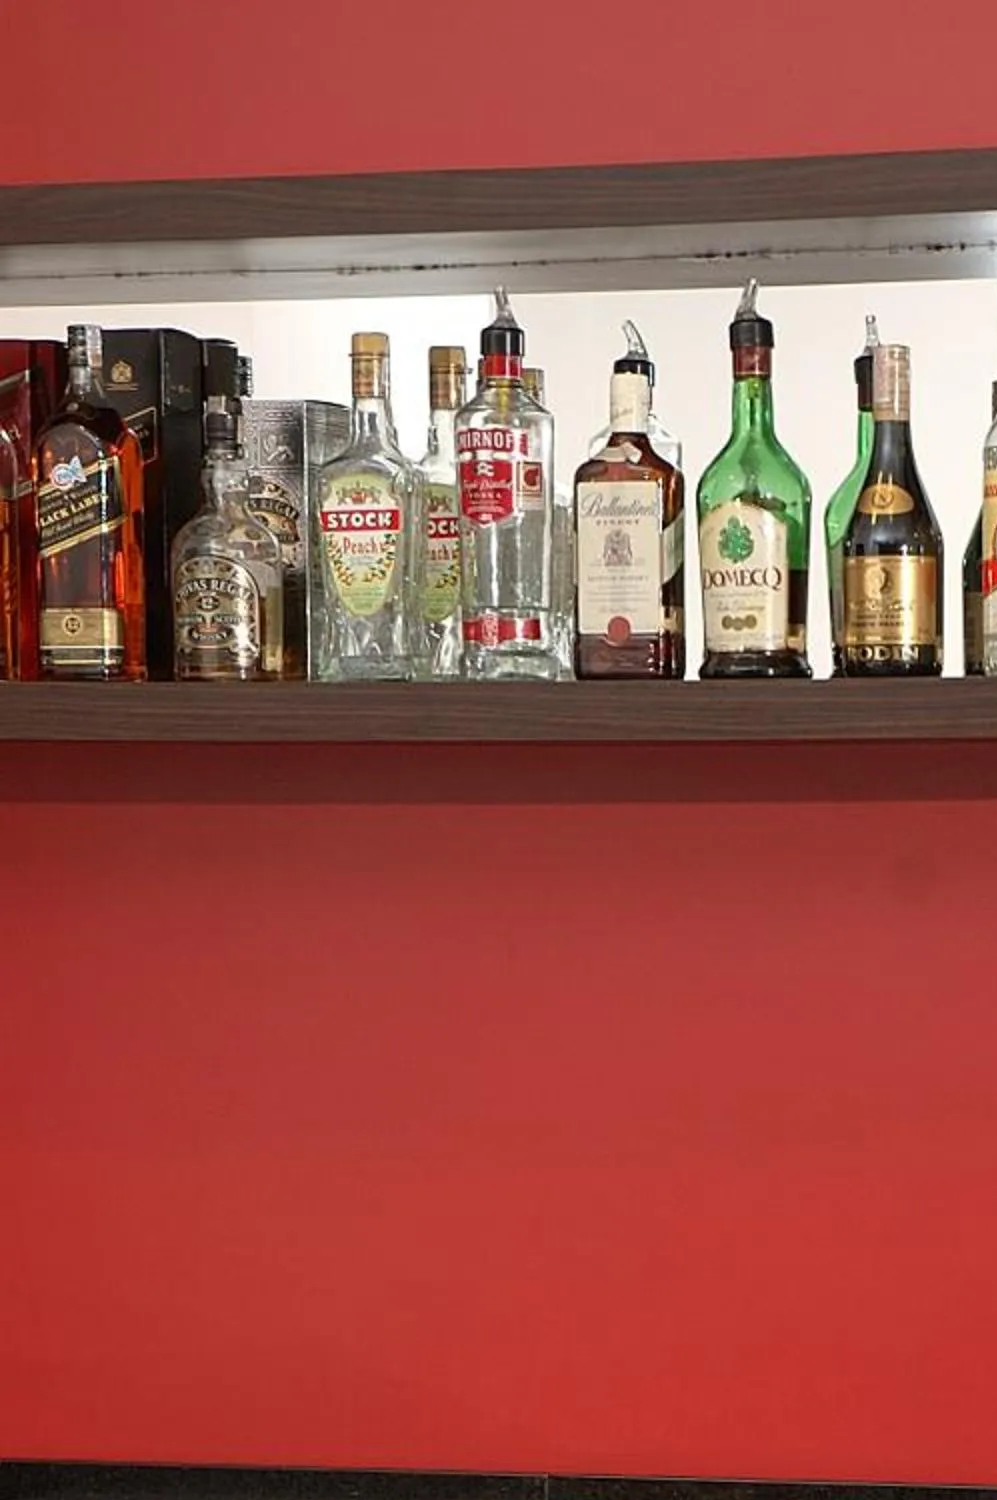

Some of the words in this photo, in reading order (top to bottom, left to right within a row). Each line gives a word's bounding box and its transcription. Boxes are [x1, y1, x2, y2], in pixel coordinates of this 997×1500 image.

[458, 431, 522, 451] MIRNOF
[39, 505, 73, 527] LACK
[70, 494, 104, 514] LABE
[327, 512, 392, 529] STOCK
[427, 520, 459, 535] OCK
[343, 537, 380, 554] Peach
[703, 567, 782, 591] DOMECQ
[210, 580, 250, 600] REG
